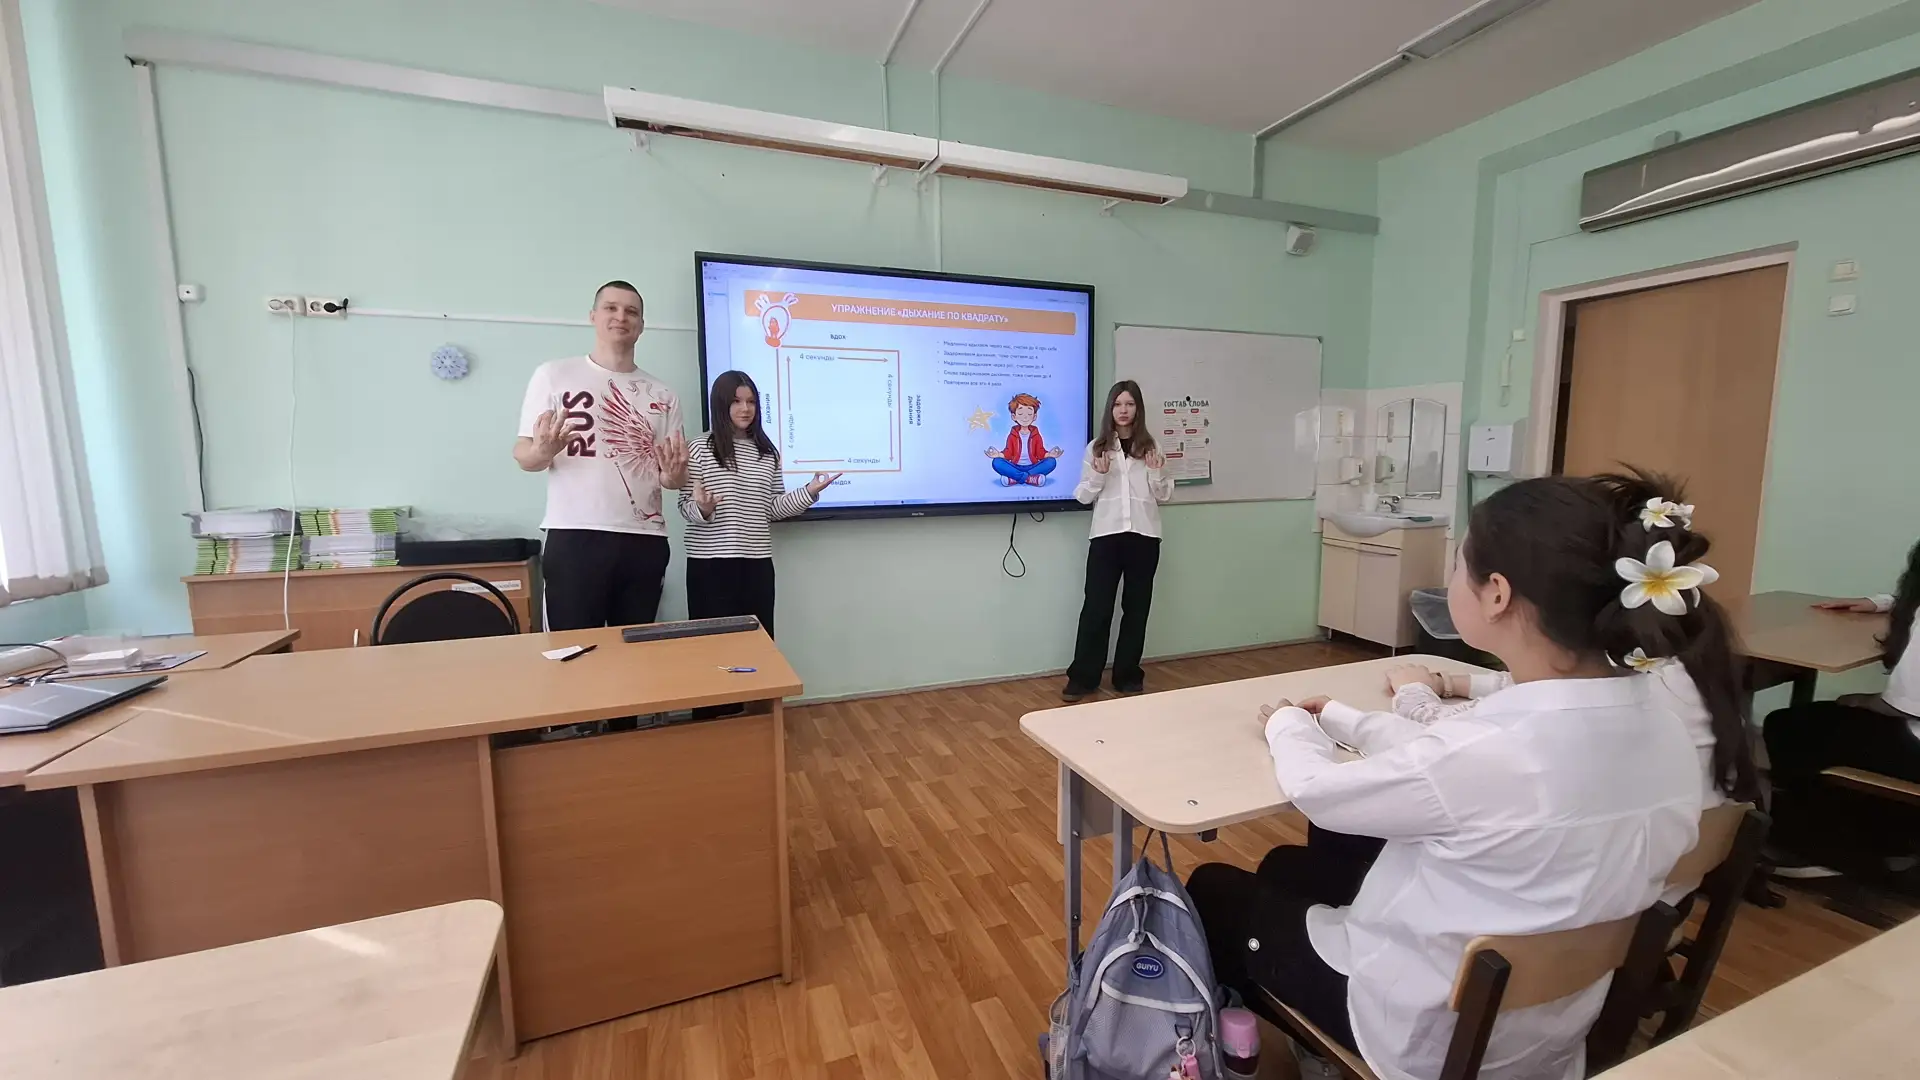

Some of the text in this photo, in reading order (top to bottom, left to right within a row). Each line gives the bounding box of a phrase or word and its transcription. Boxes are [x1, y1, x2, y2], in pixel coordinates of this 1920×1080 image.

[831, 304, 897, 316] УПРАЖНЕНИЕ
[947, 312, 960, 320] ПО
[961, 312, 1009, 323] КВАДРАТУ»
[1164, 400, 1209, 408] СОСТАВ СЛОВА
[562, 390, 597, 457] RUS
[1136, 962, 1159, 972] GUIYU
